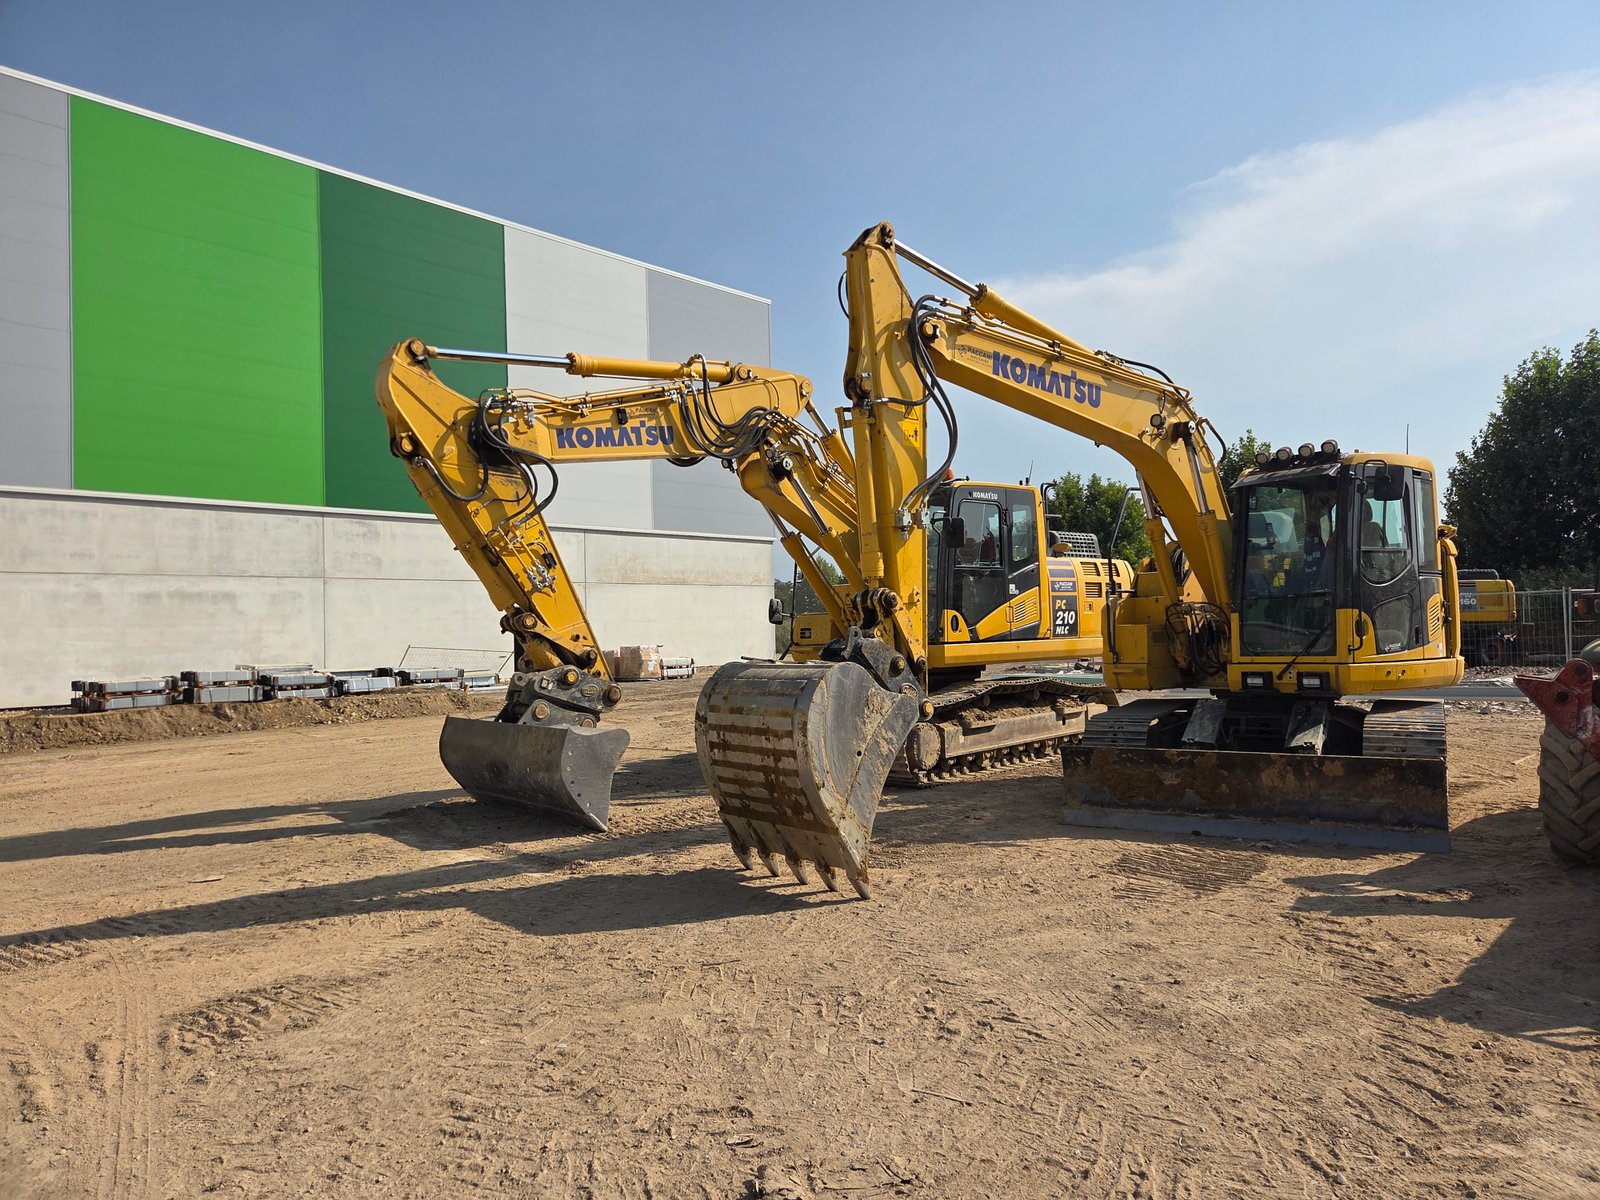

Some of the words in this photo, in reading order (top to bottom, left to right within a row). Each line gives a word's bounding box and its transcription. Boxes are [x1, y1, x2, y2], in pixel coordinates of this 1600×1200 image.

[992, 350, 1102, 408] KOMATSU
[556, 420, 675, 448] KOMATSU
[973, 491, 998, 500] KOMATSU
[1055, 599, 1067, 610] PC
[1055, 611, 1076, 625] 210
